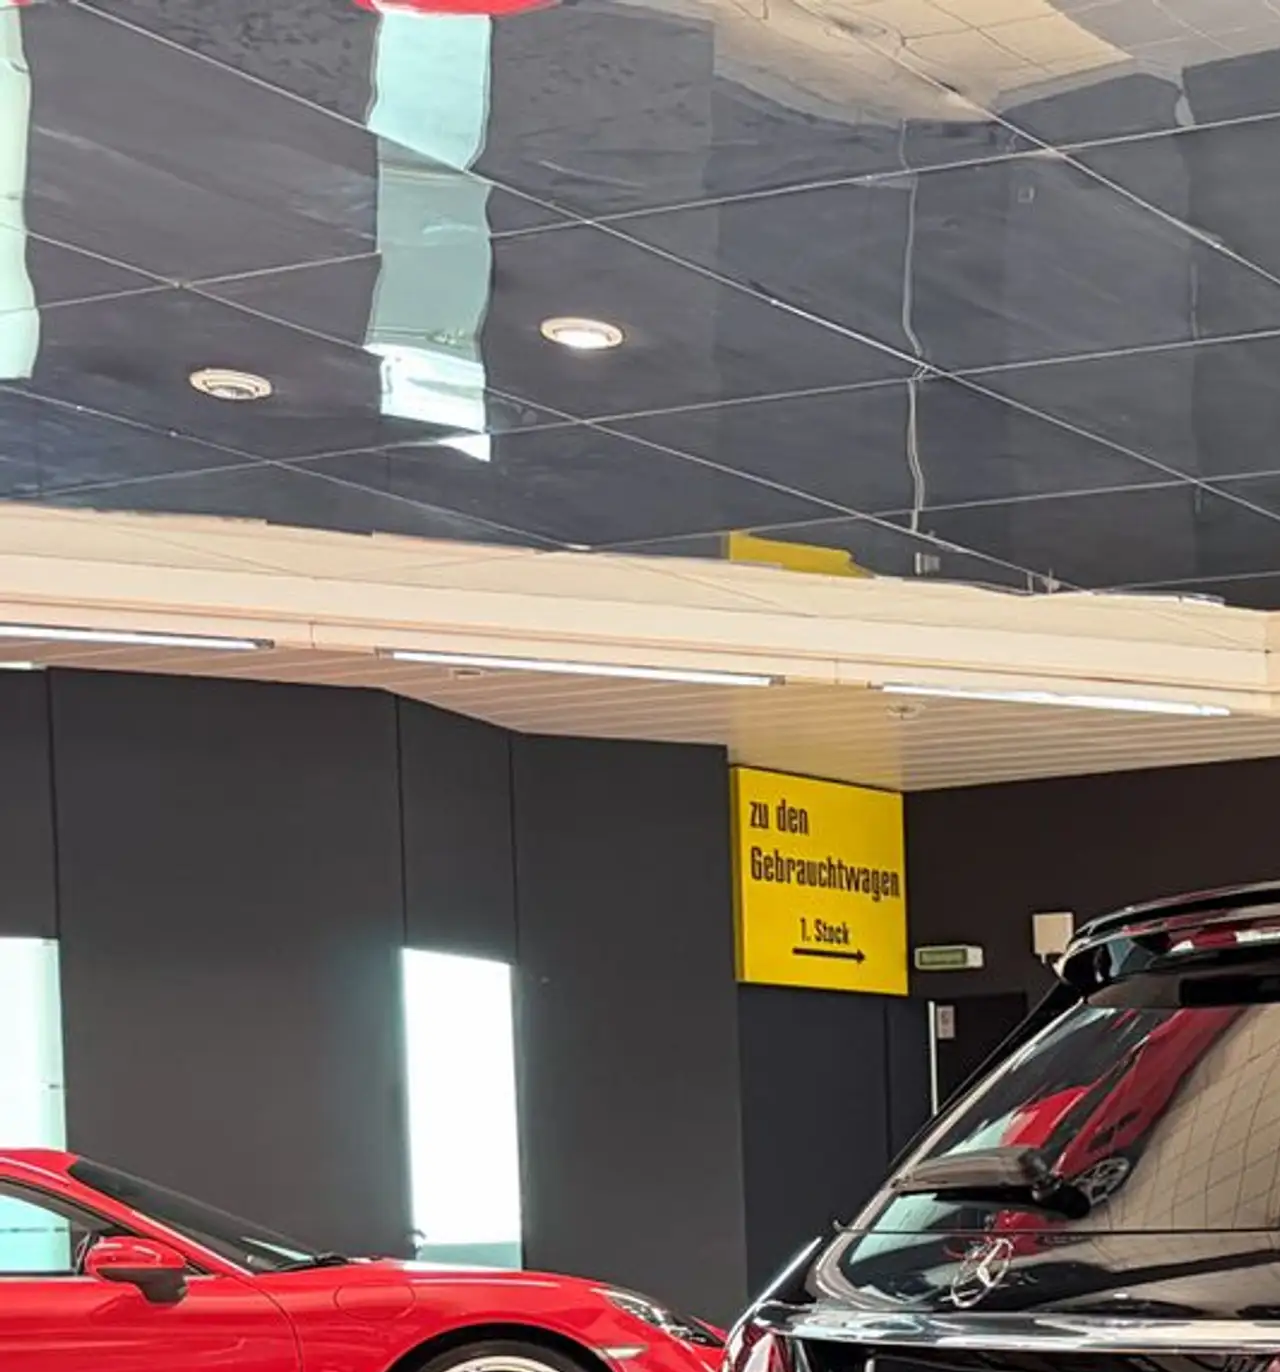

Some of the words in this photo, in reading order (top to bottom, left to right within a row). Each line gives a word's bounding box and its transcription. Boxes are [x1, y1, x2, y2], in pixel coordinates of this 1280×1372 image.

[749, 801, 769, 829] zu
[776, 799, 809, 836] den
[750, 846, 900, 902] Gebrauchtwagen
[800, 917, 811, 941] 1.
[814, 917, 850, 945] Stock
